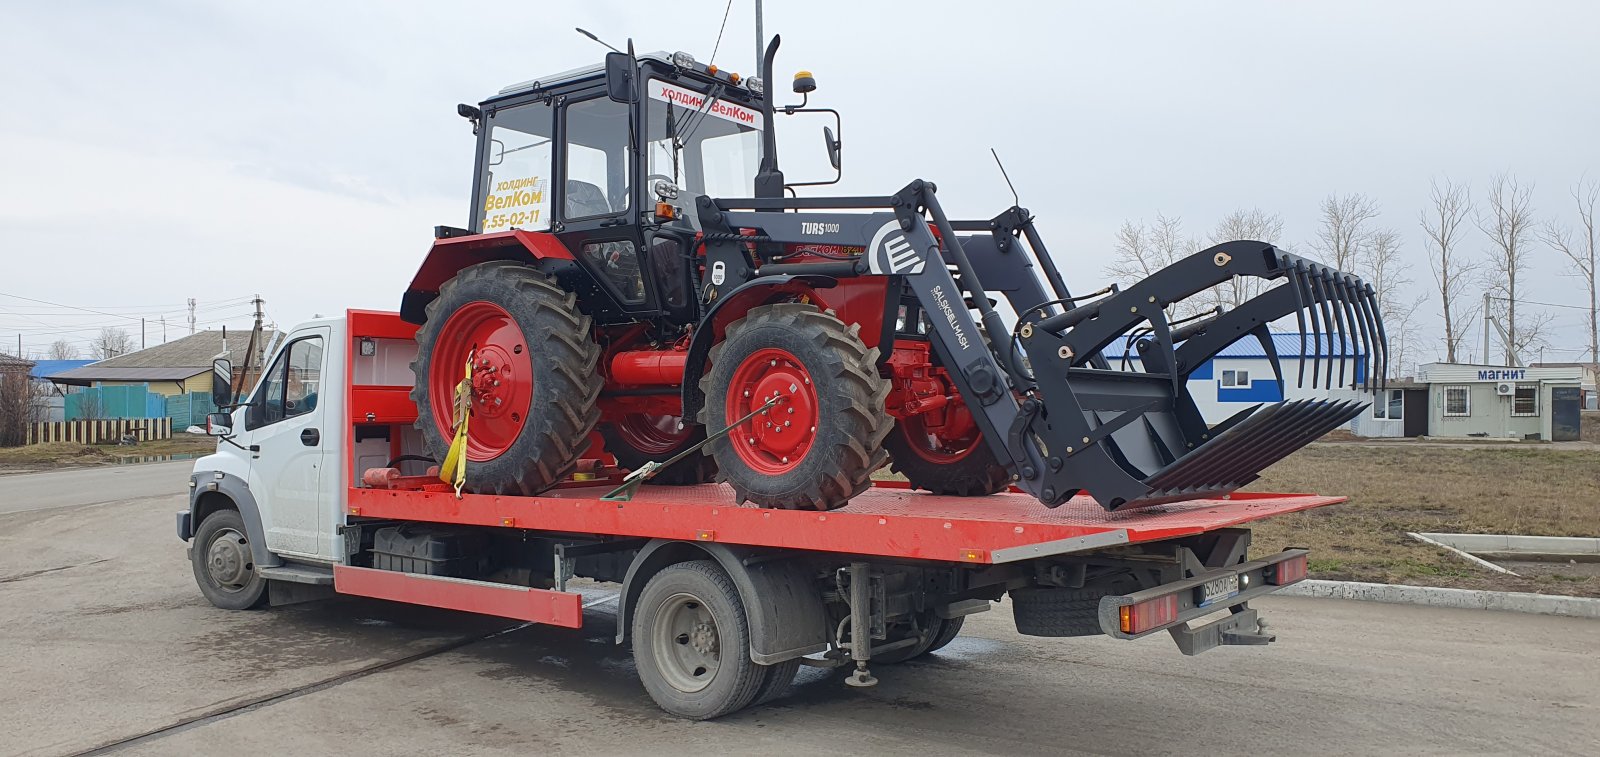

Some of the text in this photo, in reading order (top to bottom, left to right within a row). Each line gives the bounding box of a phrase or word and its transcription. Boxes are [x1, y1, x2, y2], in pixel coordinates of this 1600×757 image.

[484, 190, 542, 211] ВелКом
[801, 222, 839, 235] TURS 1000
[933, 285, 970, 350] SALSKSELMASH
